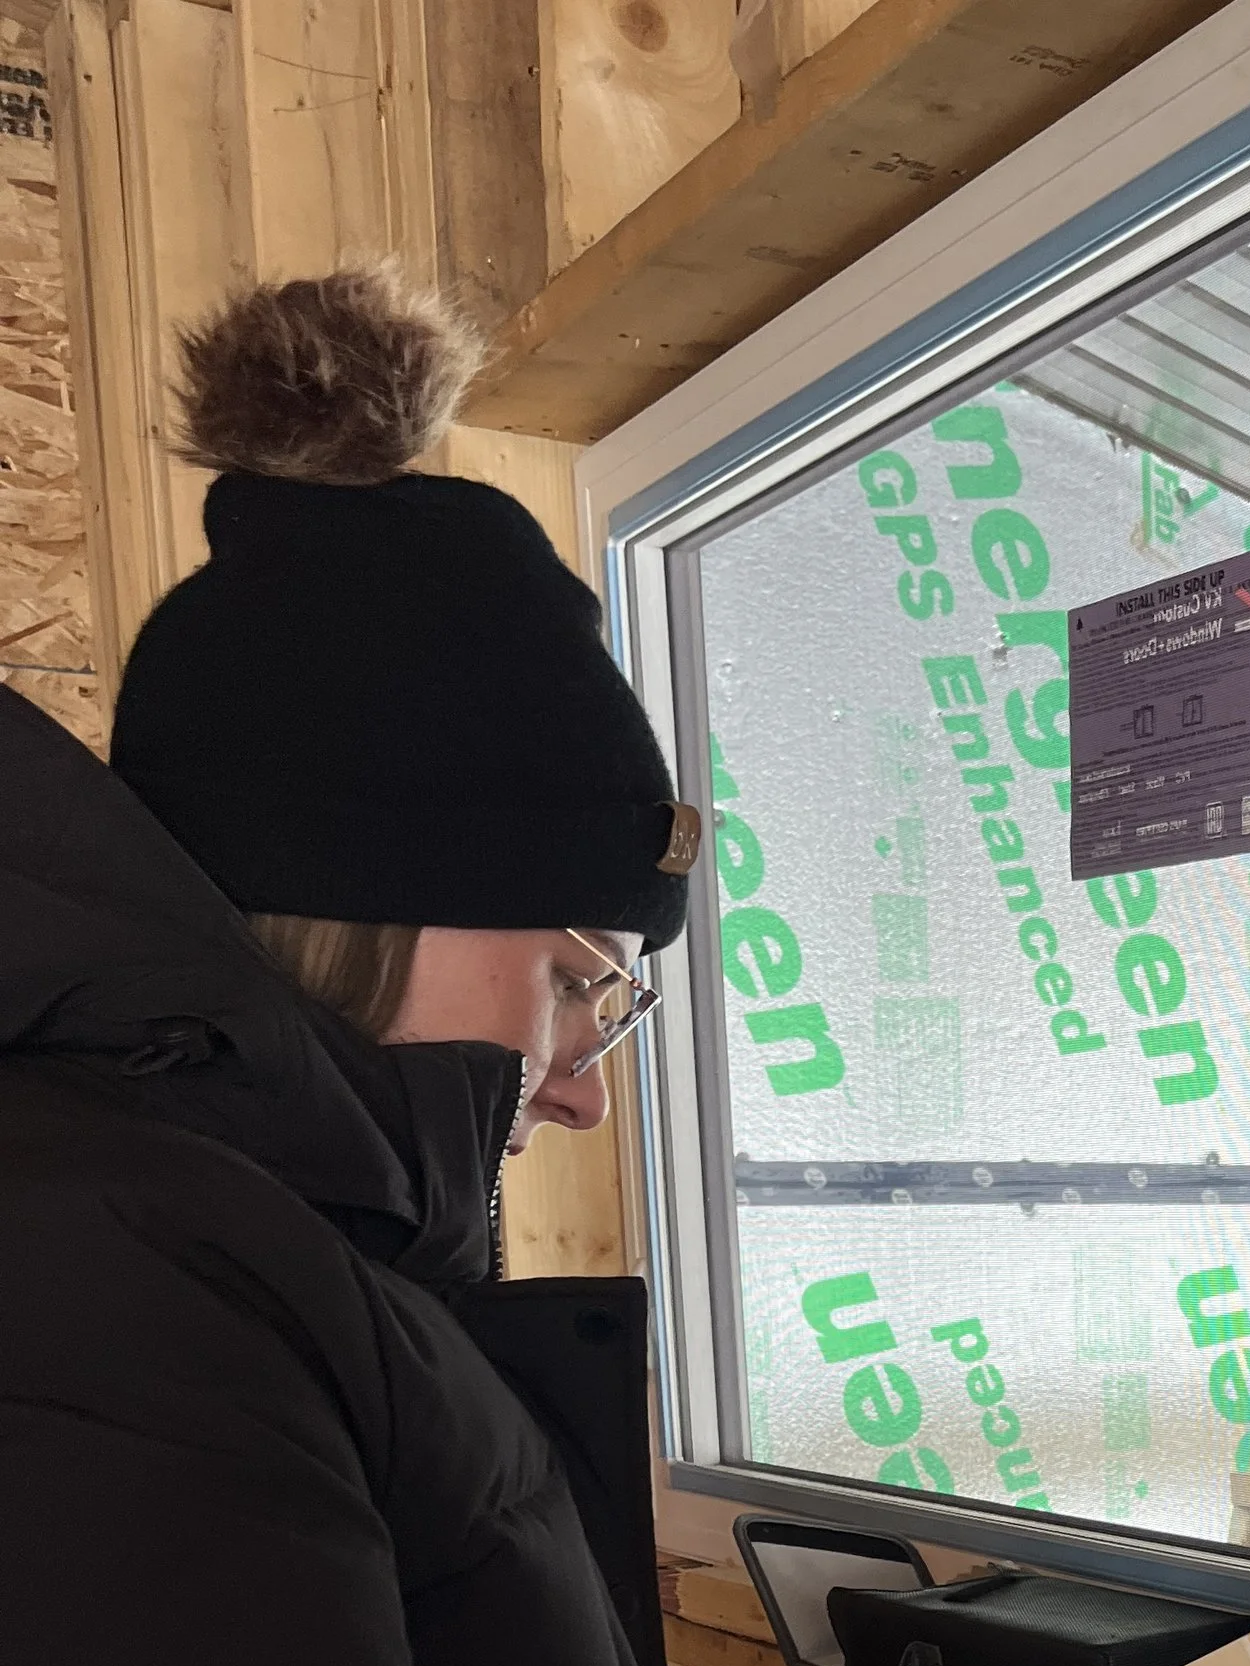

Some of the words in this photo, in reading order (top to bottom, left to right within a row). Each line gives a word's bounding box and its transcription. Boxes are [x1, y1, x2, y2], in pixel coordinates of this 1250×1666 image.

[858, 450, 954, 620] GPS
[921, 656, 1108, 1056] Enhanced
[1115, 591, 1155, 618] INSTALL
[1158, 583, 1181, 604] THIS
[1183, 578, 1207, 599] SIDE
[1209, 569, 1225, 588] UP
